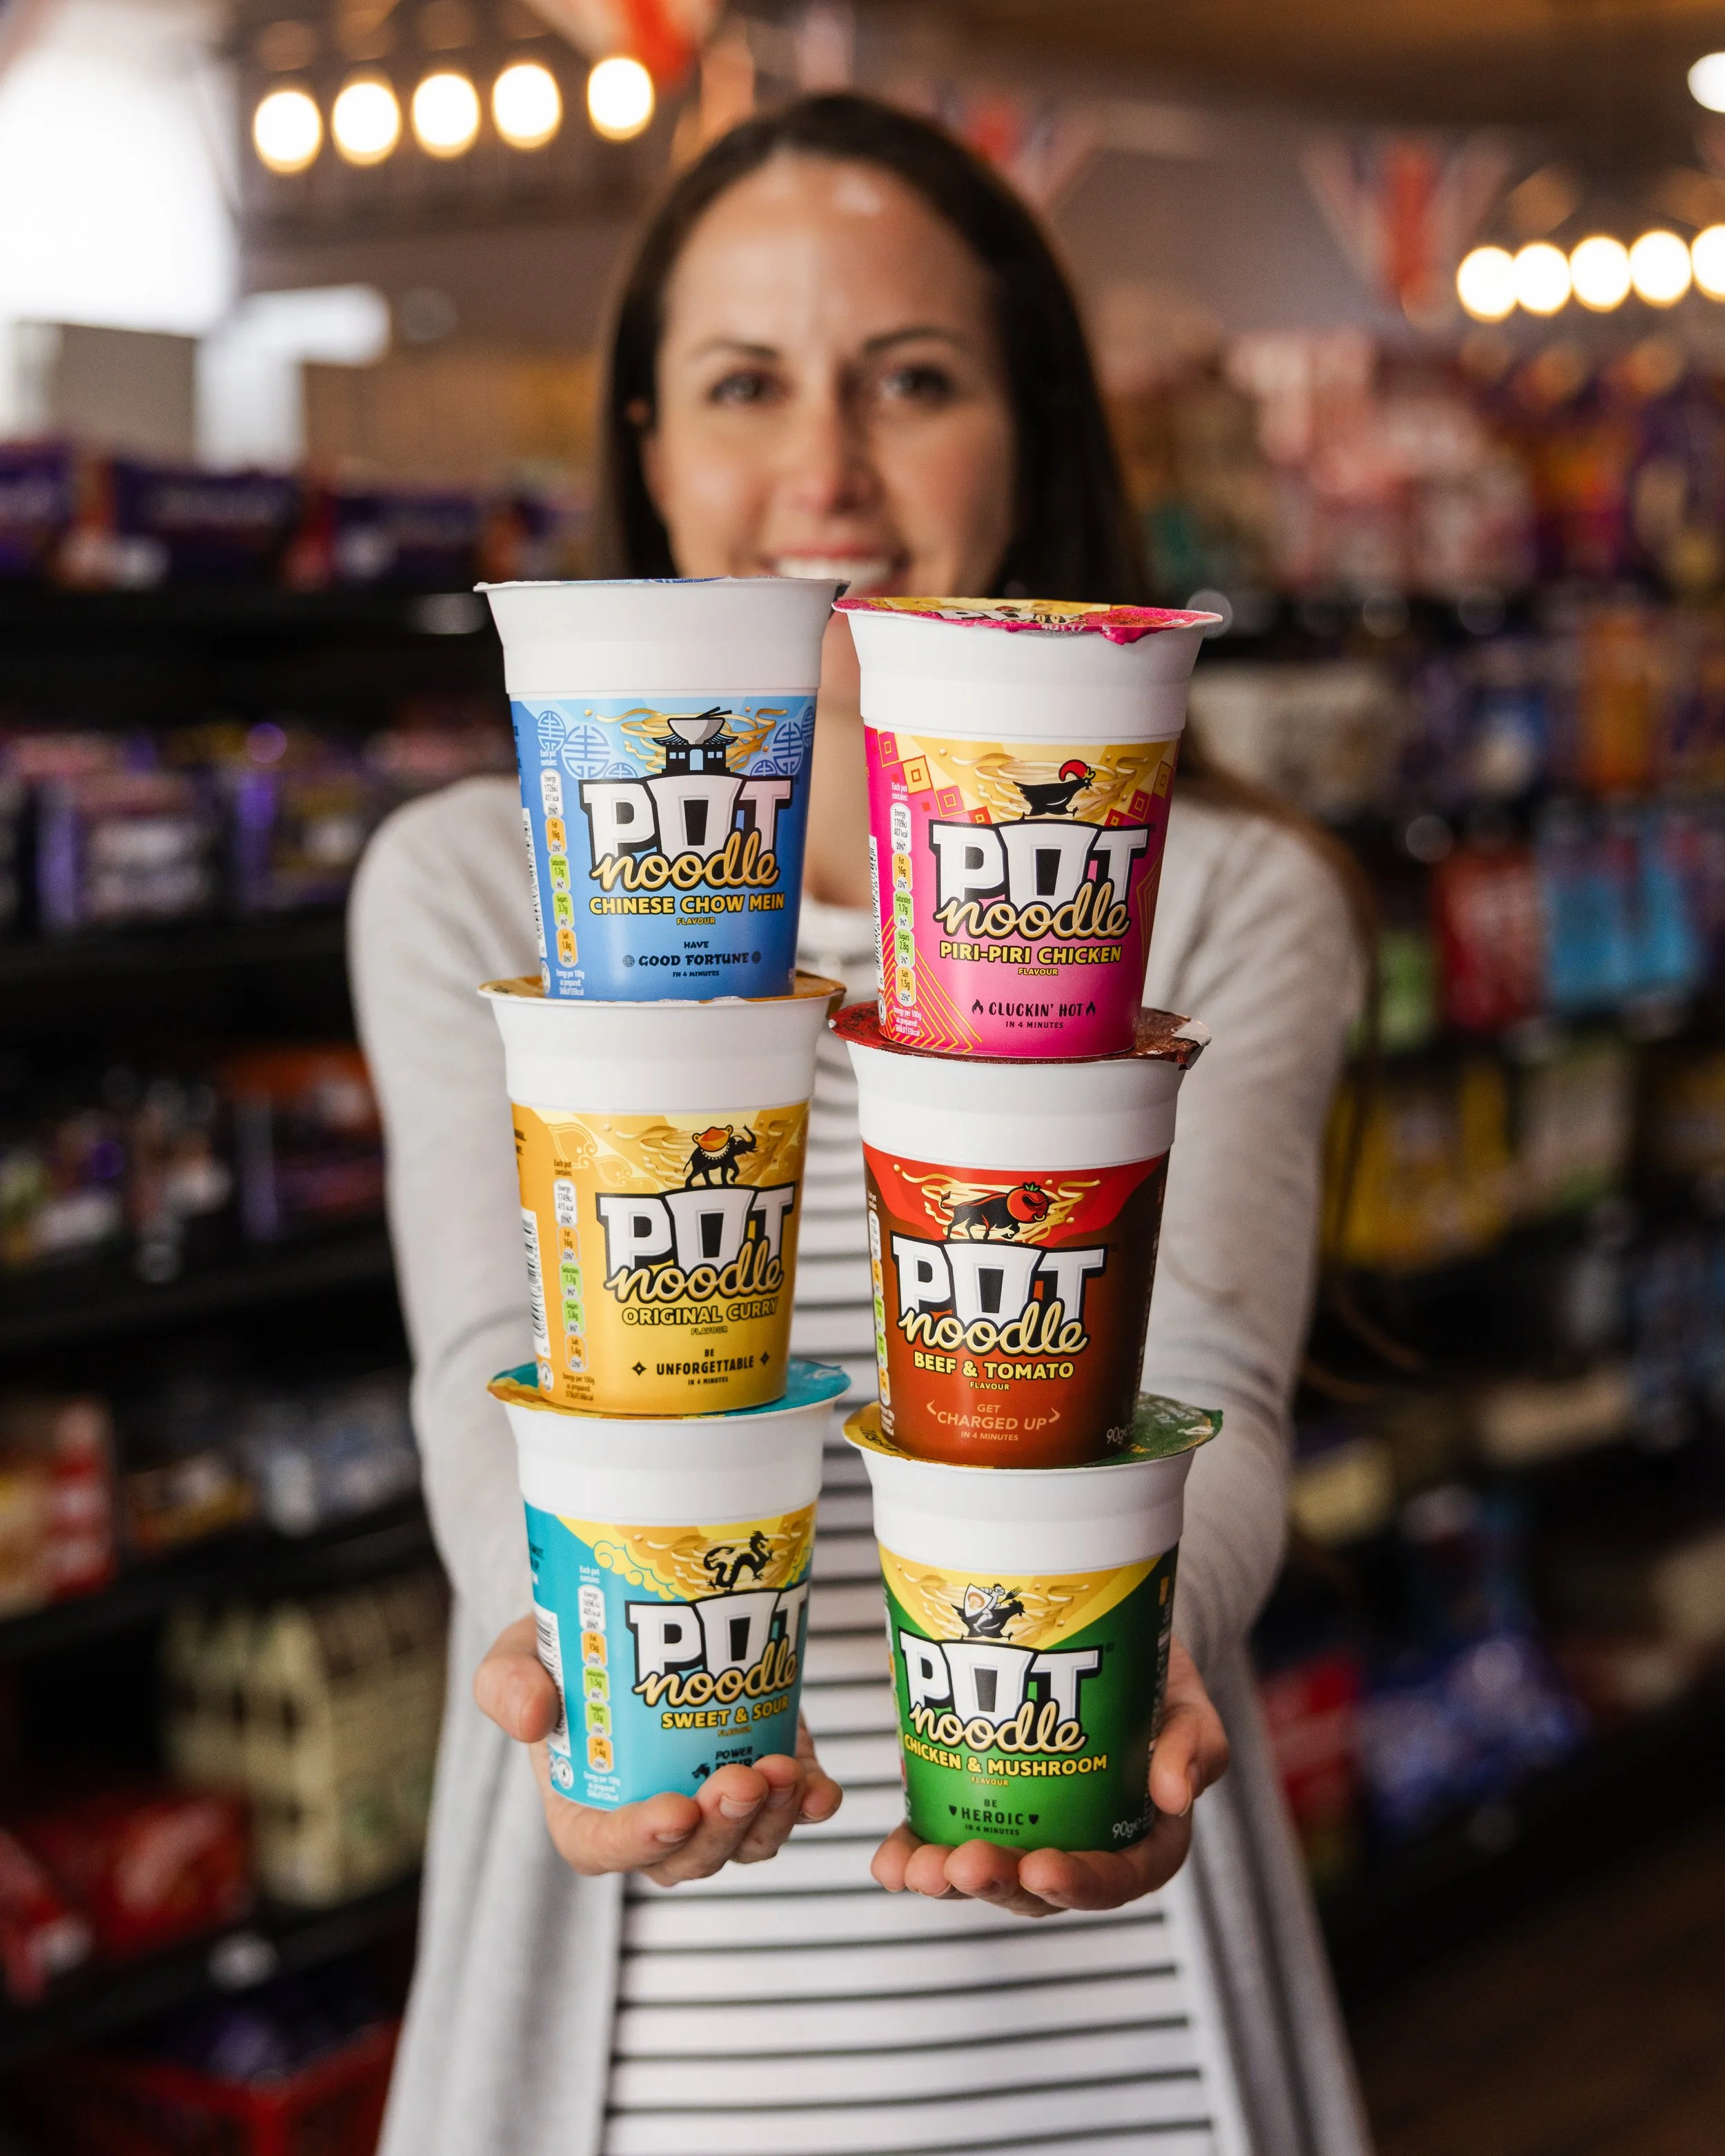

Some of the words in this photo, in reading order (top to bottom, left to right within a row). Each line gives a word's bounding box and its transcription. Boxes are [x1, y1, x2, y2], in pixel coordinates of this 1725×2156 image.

[544, 775, 556, 783] Energy
[891, 782, 900, 791] Each
[579, 773, 793, 865] POT
[894, 809, 906, 819] Energy
[894, 818, 907, 829] 1709kJ
[589, 829, 780, 891] noodle
[929, 820, 1152, 908] POT
[898, 866, 906, 877] 16g
[589, 896, 676, 916] CHINESE
[680, 895, 746, 914] CHOW
[748, 892, 785, 912] MEIN
[896, 894, 911, 904] Saturates
[898, 904, 908, 915] 1.7g
[934, 880, 1131, 940] noodle
[676, 916, 716, 925] FLAVOUR
[898, 931, 910, 941] Sugars
[683, 940, 709, 949] HAVE
[900, 941, 909, 953] 2.8g
[940, 941, 1031, 964] PIRI-PIRI
[1036, 945, 1123, 965] CHICKEN
[638, 954, 680, 967] GOOD
[686, 952, 749, 965] FORTUNE
[689, 969, 720, 978] MINUTES
[1018, 967, 1058, 976] FLAVOUR
[900, 980, 910, 990] 1.5g
[893, 1005, 904, 1017] Energy
[911, 1009, 921, 1021] 100g
[1058, 1002, 1083, 1016] HOT
[1026, 1021, 1064, 1029] MINUTES
[553, 1159, 564, 1167] Each
[558, 1184, 571, 1193] Energy
[595, 1184, 795, 1278] POT
[564, 1238, 573, 1248] 16g
[603, 1238, 784, 1303] noodle
[891, 1232, 1107, 1318] POT
[566, 1275, 576, 1285] 1.7g
[622, 1305, 722, 1325] ORIGINAL
[726, 1296, 778, 1322] CURRY
[691, 1325, 728, 1336] FLAVOUR
[898, 1298, 1090, 1356] noodle
[656, 1357, 753, 1375] UNFORGETTABLE
[914, 1350, 957, 1374] BEEF
[962, 1361, 978, 1378] &
[984, 1362, 1074, 1380] TOMATO
[703, 1376, 729, 1385] MINUTES
[969, 1381, 1010, 1391] FLAVOUR
[977, 1404, 1000, 1413] GET
[936, 1410, 1018, 1430] CHARGED
[1024, 1416, 1047, 1430] UP
[980, 1432, 1019, 1441] MINUTES
[626, 1584, 808, 1681] POT
[589, 1643, 599, 1652] 15g
[632, 1636, 798, 1707] noodle
[898, 1628, 1103, 1719] POT
[661, 1709, 729, 1730] SWEET
[735, 1707, 748, 1723] &
[753, 1695, 789, 1720] SOUR
[909, 1699, 1087, 1754] noodle
[716, 1745, 753, 1759] POWER
[904, 1733, 962, 1770] CHICKEN
[967, 1756, 983, 1774] &
[987, 1754, 1108, 1778] MUSHROOM
[971, 1775, 1009, 1786] FLAVOUR
[984, 1799, 997, 1808] BE
[961, 1806, 1024, 1825] HEROIC
[983, 1826, 1020, 1836] MINUTES
